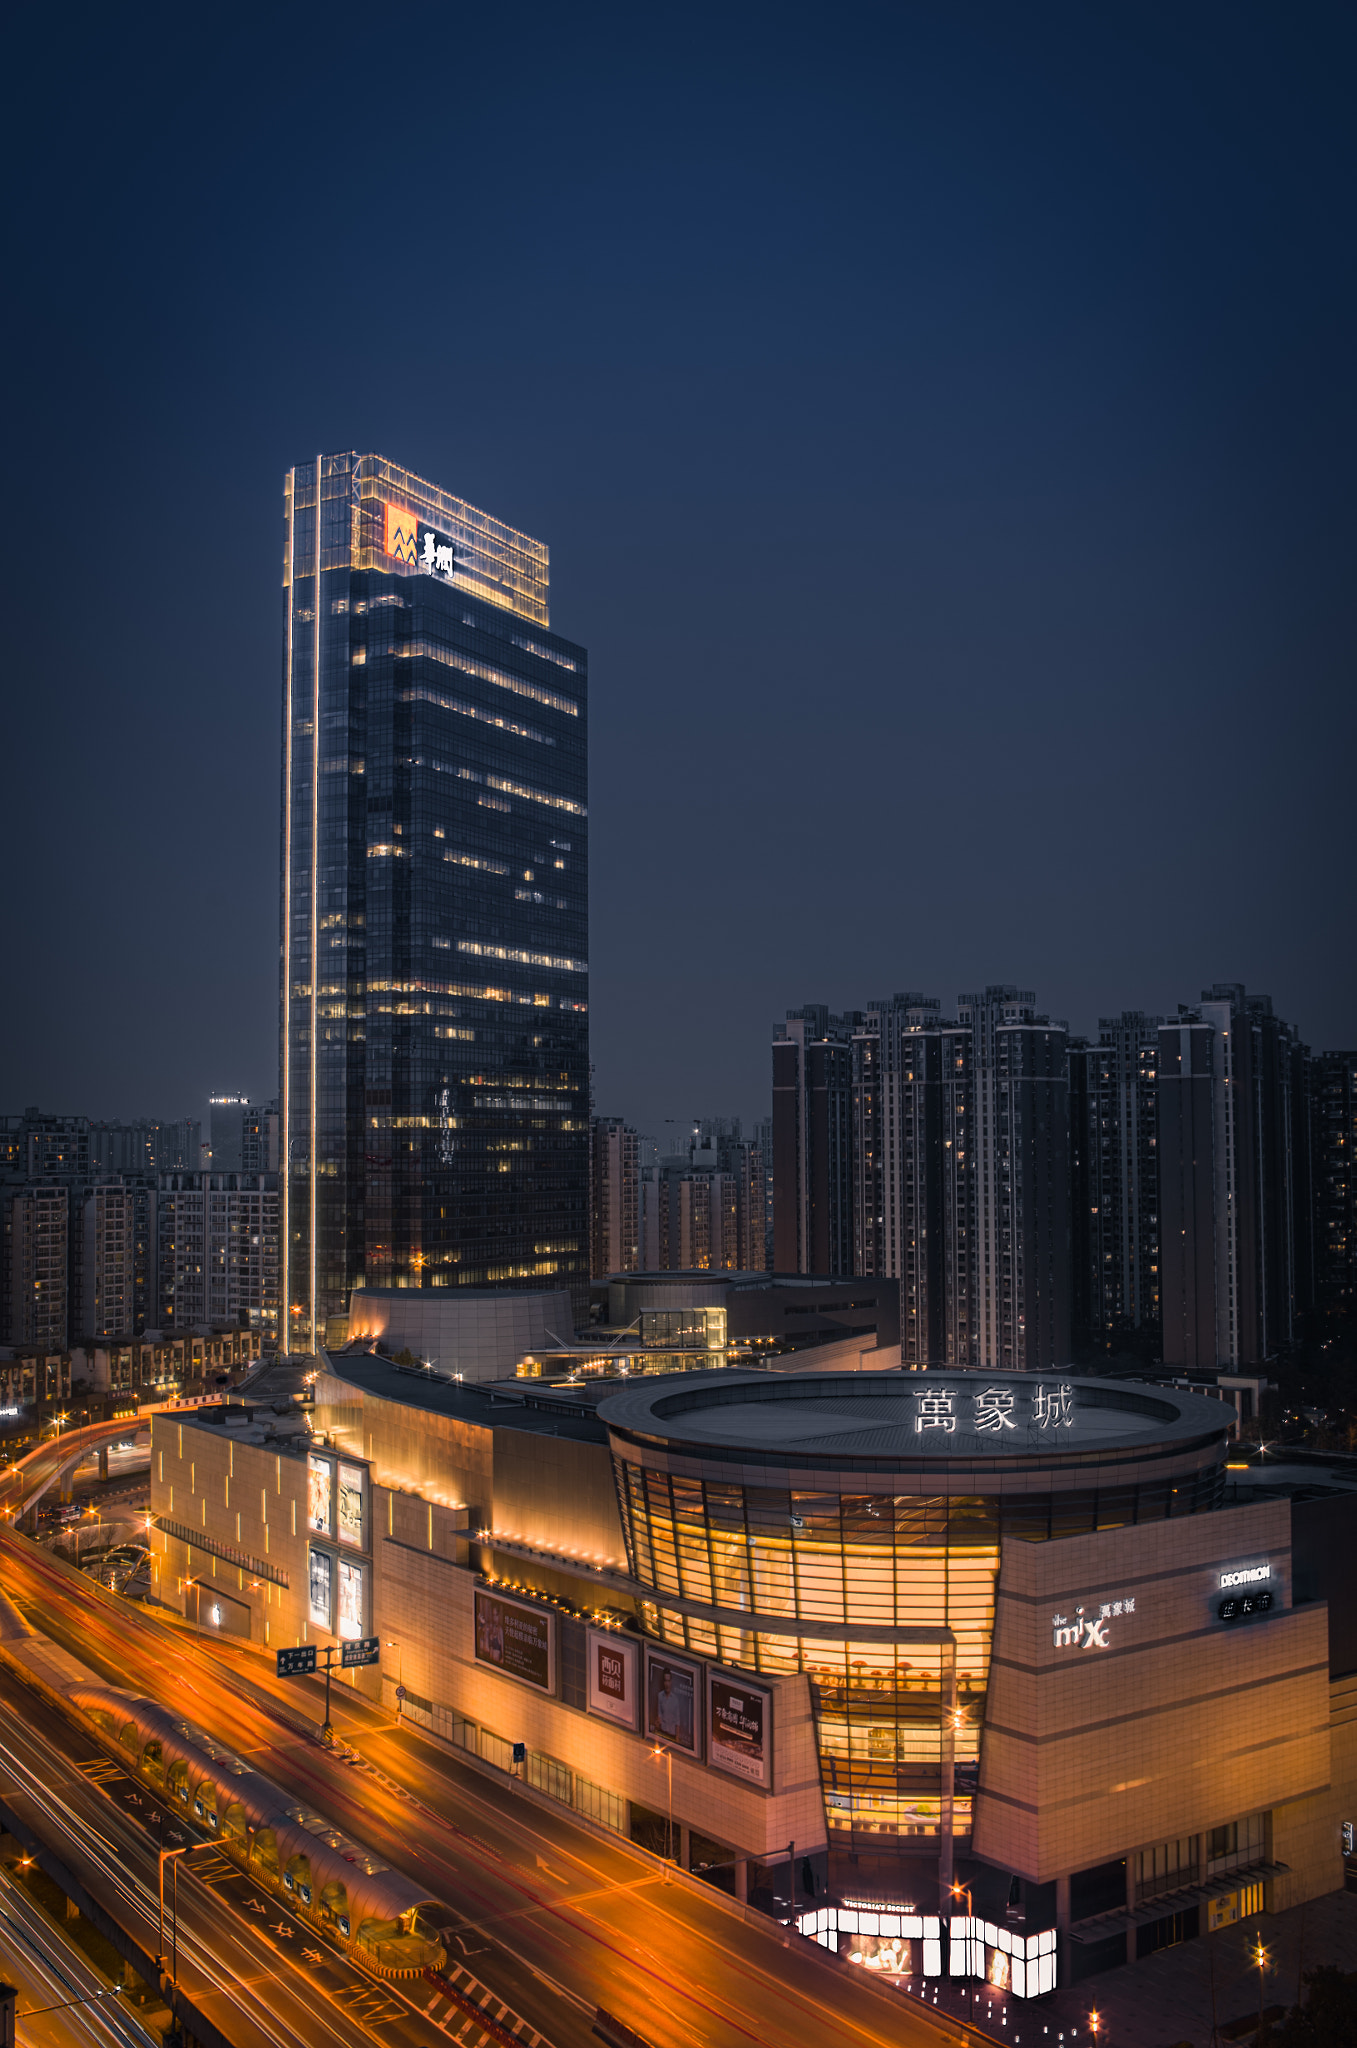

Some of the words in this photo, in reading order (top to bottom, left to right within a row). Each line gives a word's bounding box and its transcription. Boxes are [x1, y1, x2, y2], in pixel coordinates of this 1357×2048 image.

[913, 1384, 1073, 1433] 萬象城
[1220, 1565, 1271, 1588] DECATHLON
[1053, 1614, 1068, 1627] the
[288, 1650, 313, 1659] 下一出口
[602, 1655, 621, 1679] 西贝
[844, 1900, 886, 1911] VICTORIA'S
[887, 1904, 915, 1913] SECRET
